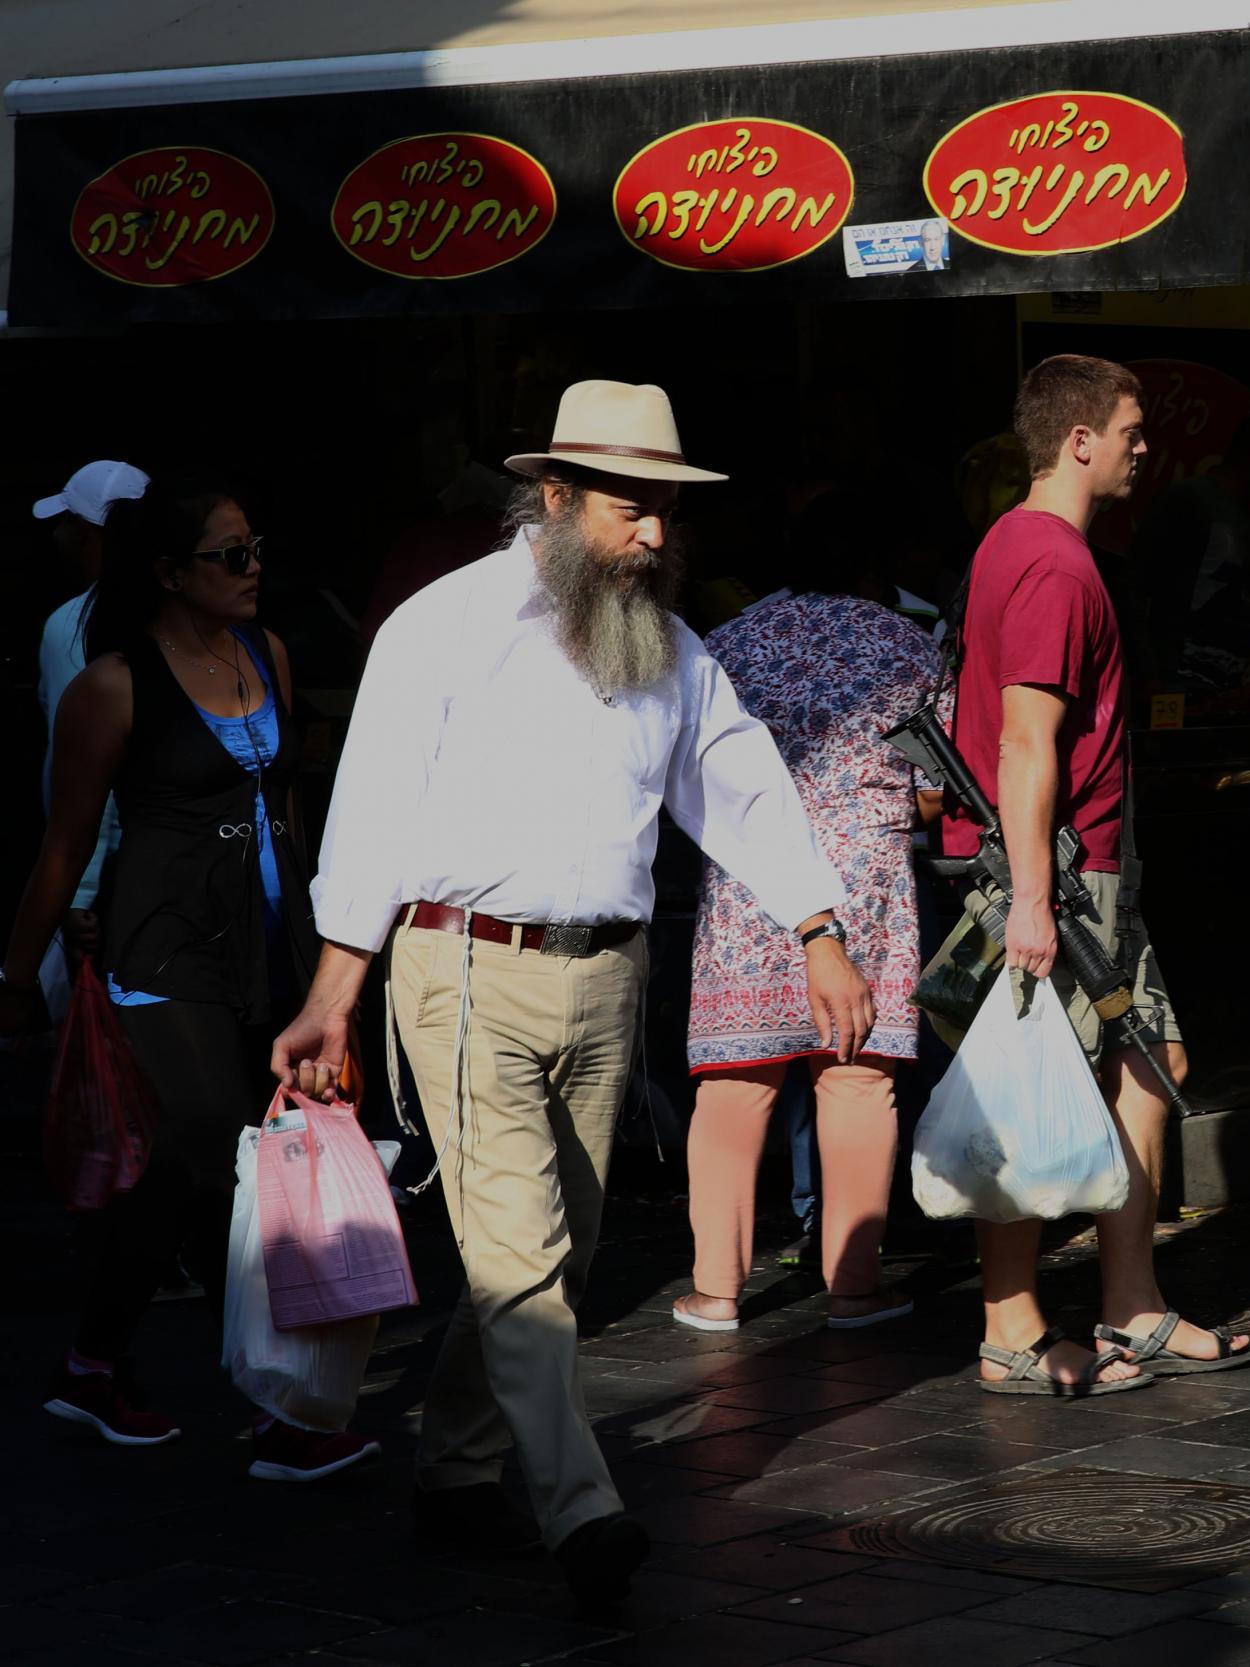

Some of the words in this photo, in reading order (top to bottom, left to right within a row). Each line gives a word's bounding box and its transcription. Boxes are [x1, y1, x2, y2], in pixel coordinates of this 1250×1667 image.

[687, 127, 780, 179] פיצוחי
[1008, 101, 1112, 156] פיצוחי
[134, 155, 212, 200] פיצוחי
[401, 142, 485, 189] פיצוחי
[1142, 371, 1209, 435] פיצו
